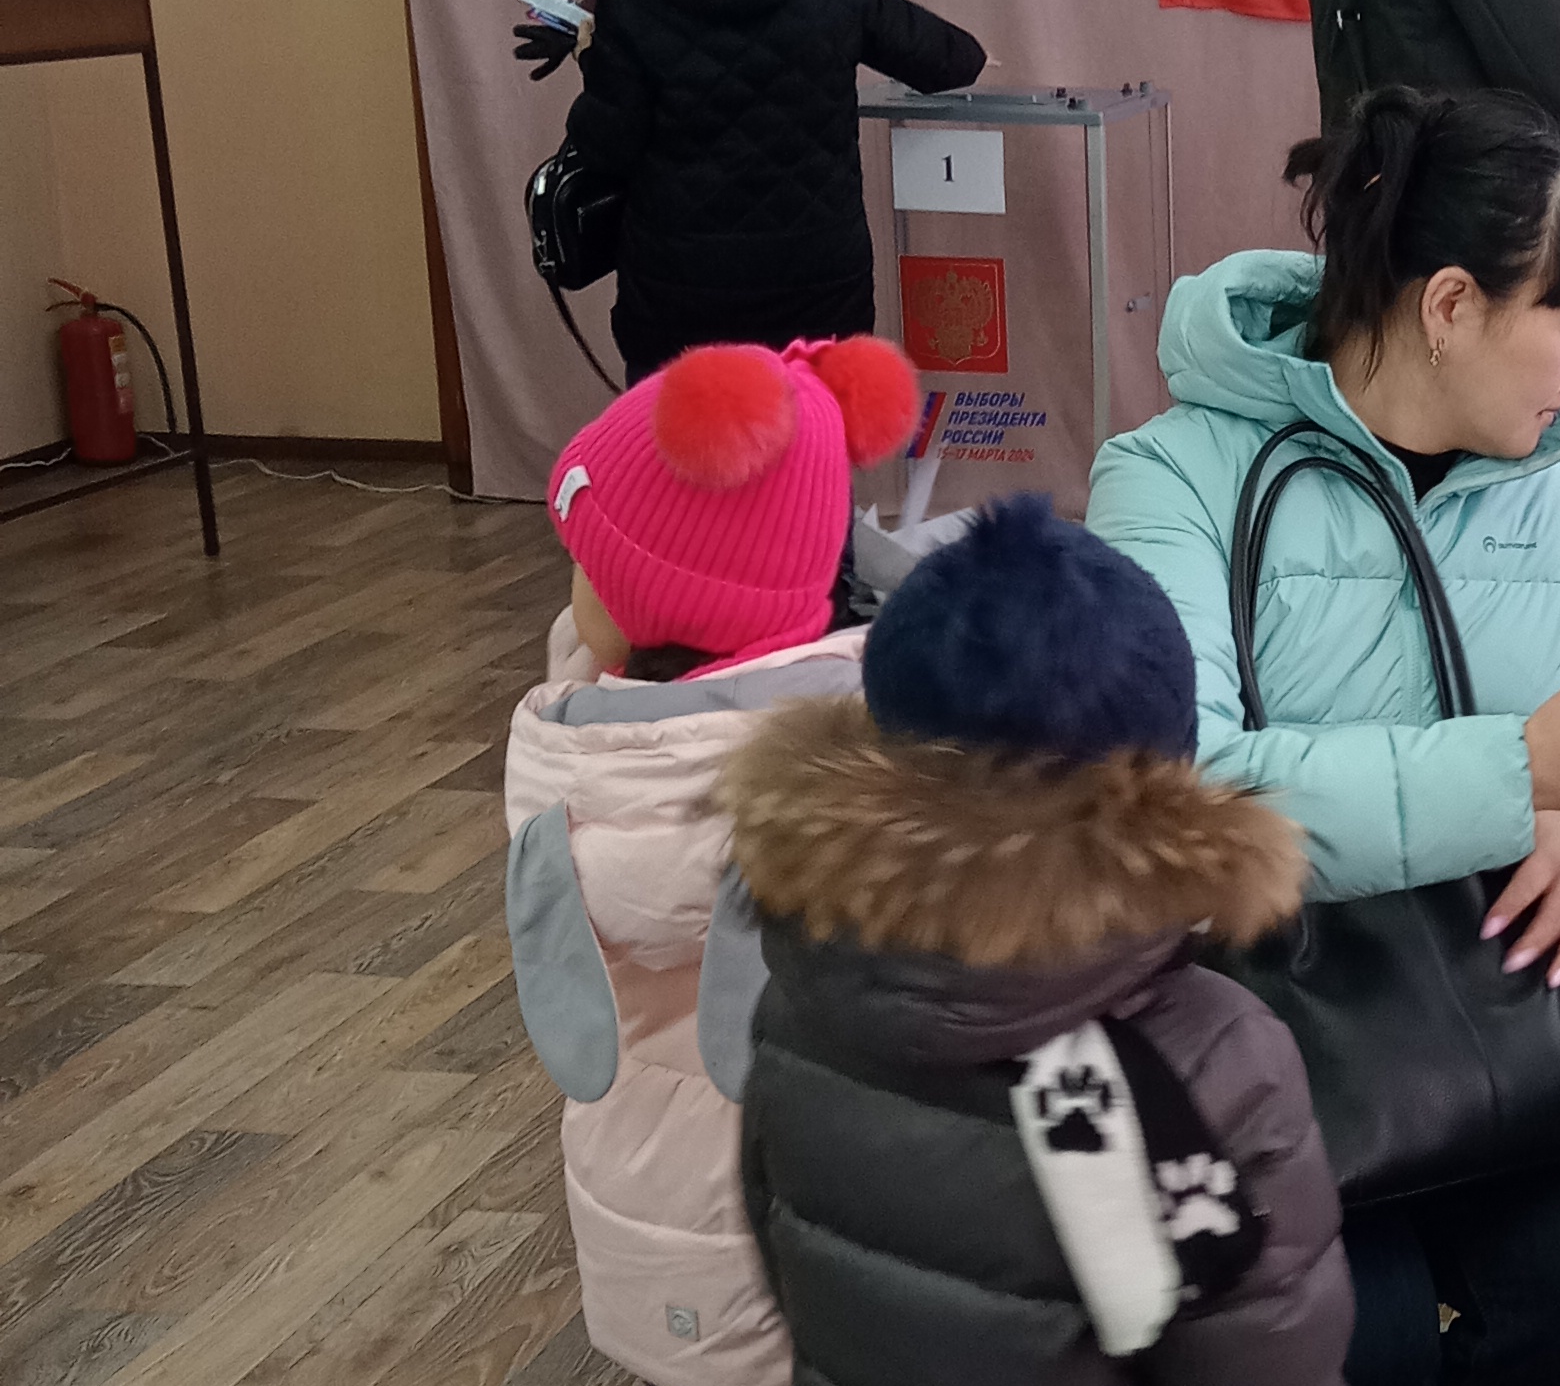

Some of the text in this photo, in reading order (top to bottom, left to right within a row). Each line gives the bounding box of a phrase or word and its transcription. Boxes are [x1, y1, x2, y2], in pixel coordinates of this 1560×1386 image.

[942, 155, 954, 183] 1
[955, 392, 1025, 407] ВЫБОРЫ
[948, 412, 1047, 427] ПРЕЗИДЕНТА
[941, 429, 1005, 445] РОССИИ
[967, 448, 1005, 461] МАРТА
